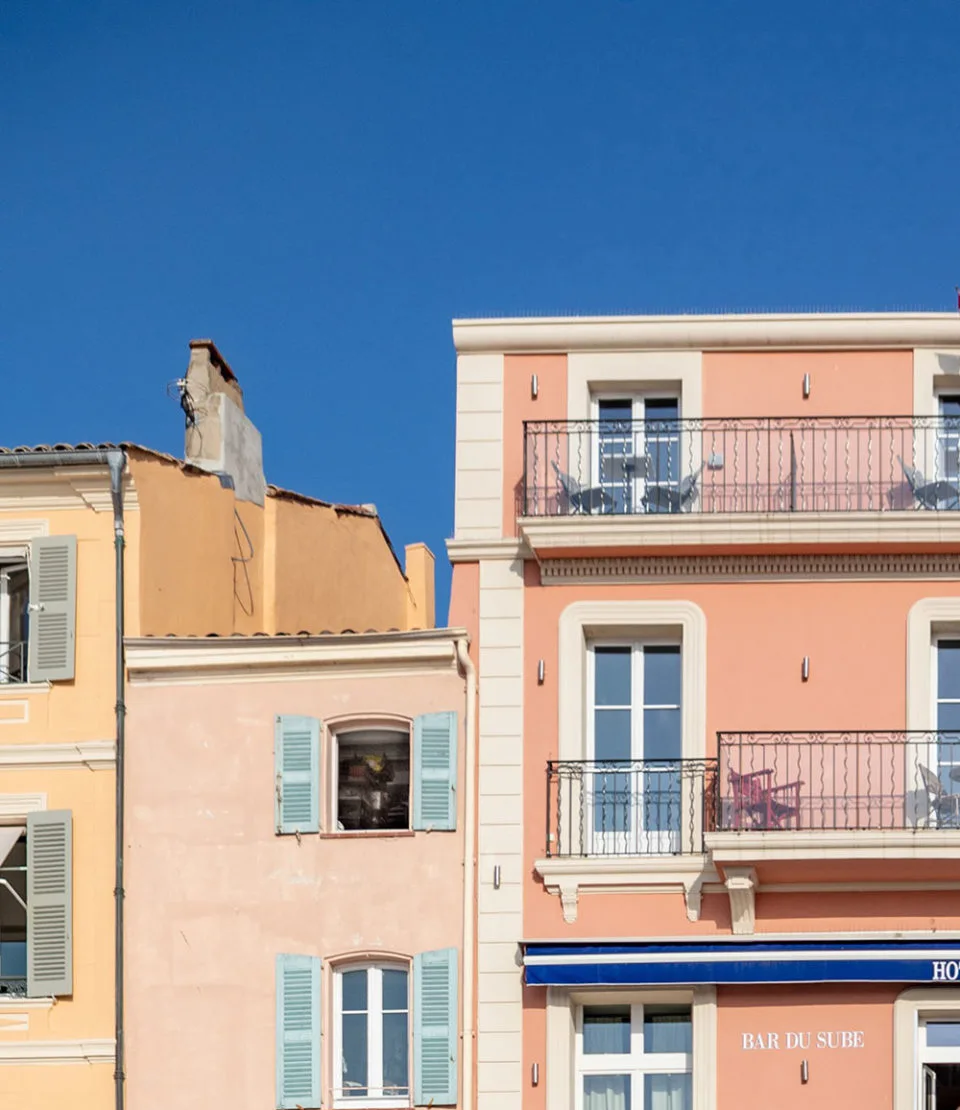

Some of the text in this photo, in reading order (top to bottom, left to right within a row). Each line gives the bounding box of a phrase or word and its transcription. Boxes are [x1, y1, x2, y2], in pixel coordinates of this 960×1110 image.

[741, 1031, 865, 1049] BAR DU SUBE
